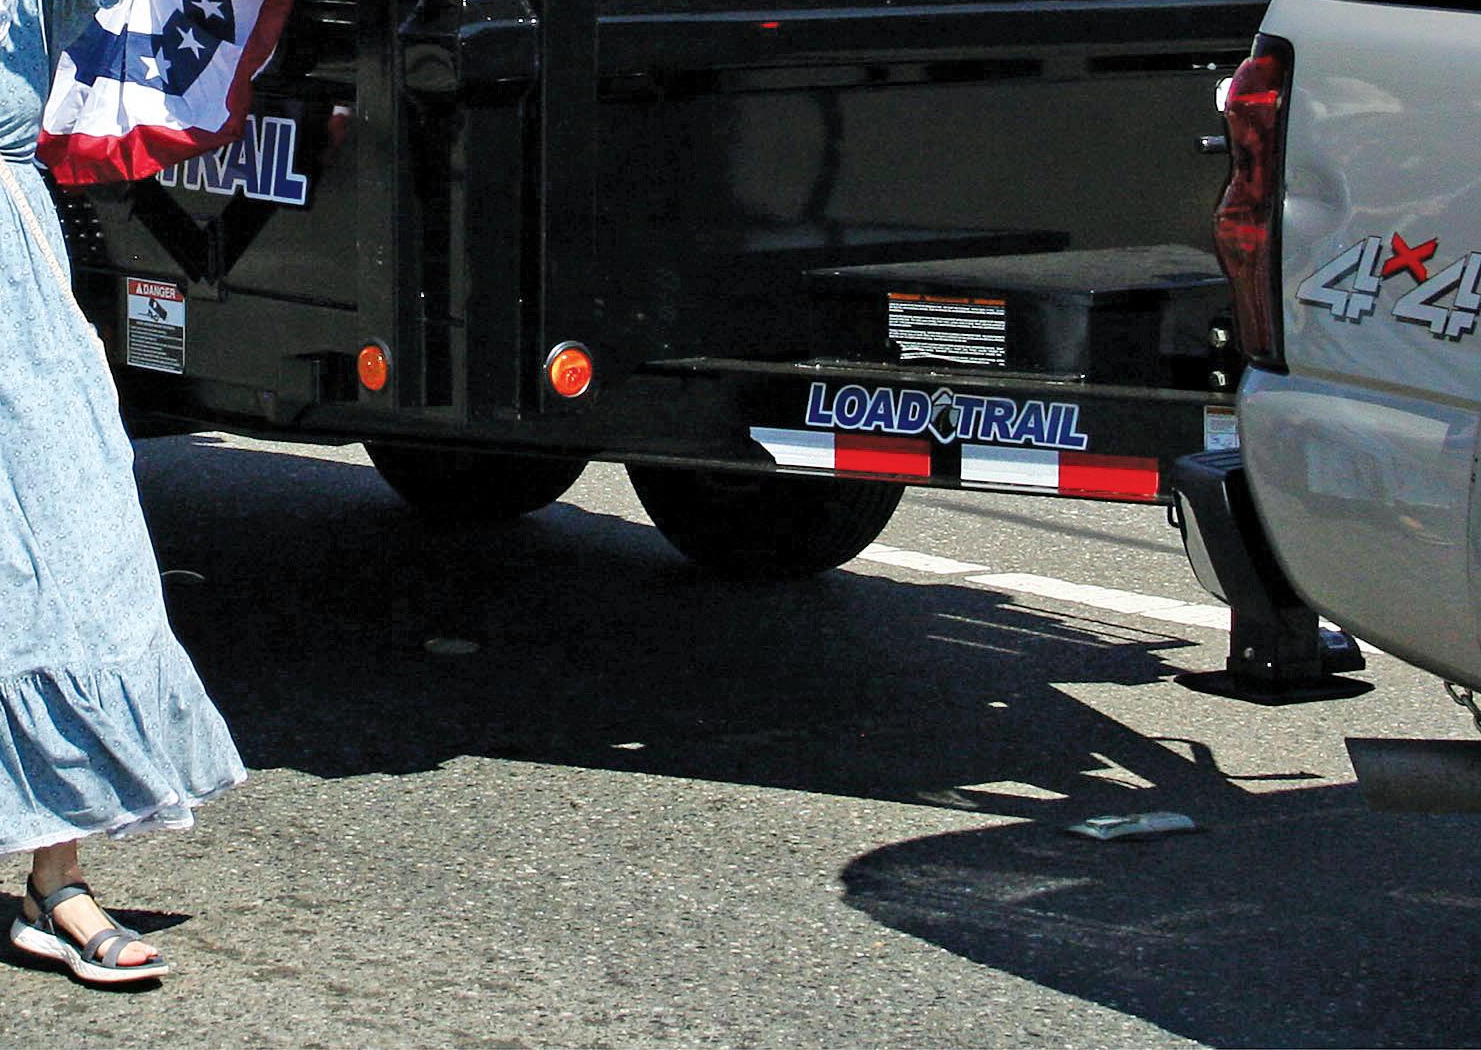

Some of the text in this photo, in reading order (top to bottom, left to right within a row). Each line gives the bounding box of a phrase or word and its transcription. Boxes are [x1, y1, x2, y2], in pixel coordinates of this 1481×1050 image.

[143, 284, 176, 299] DANGER
[805, 381, 1089, 450] LOAD TRAIL
